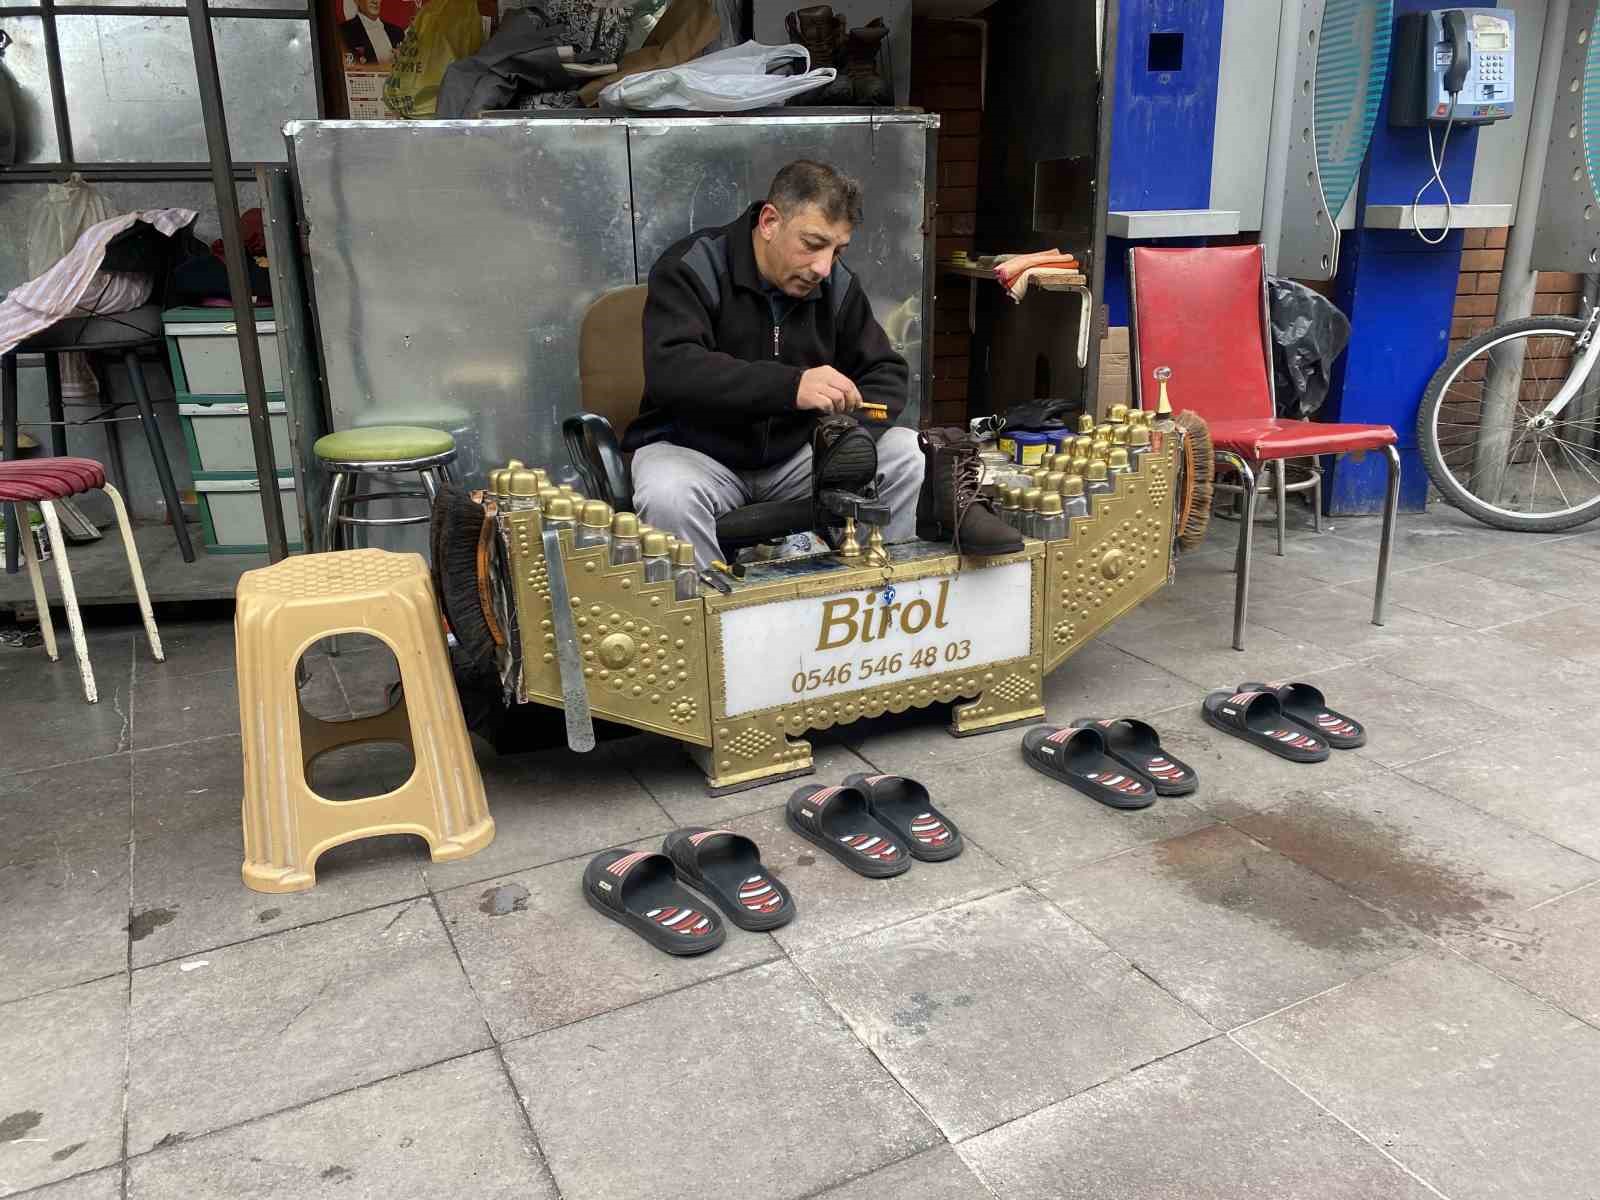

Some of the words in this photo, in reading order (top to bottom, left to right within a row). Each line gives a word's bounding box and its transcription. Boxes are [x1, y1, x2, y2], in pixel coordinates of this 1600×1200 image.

[815, 580, 950, 651] Birol
[792, 662, 851, 693] 0546
[858, 653, 902, 680] 546
[910, 646, 937, 668] 48
[945, 640, 971, 662] 03
